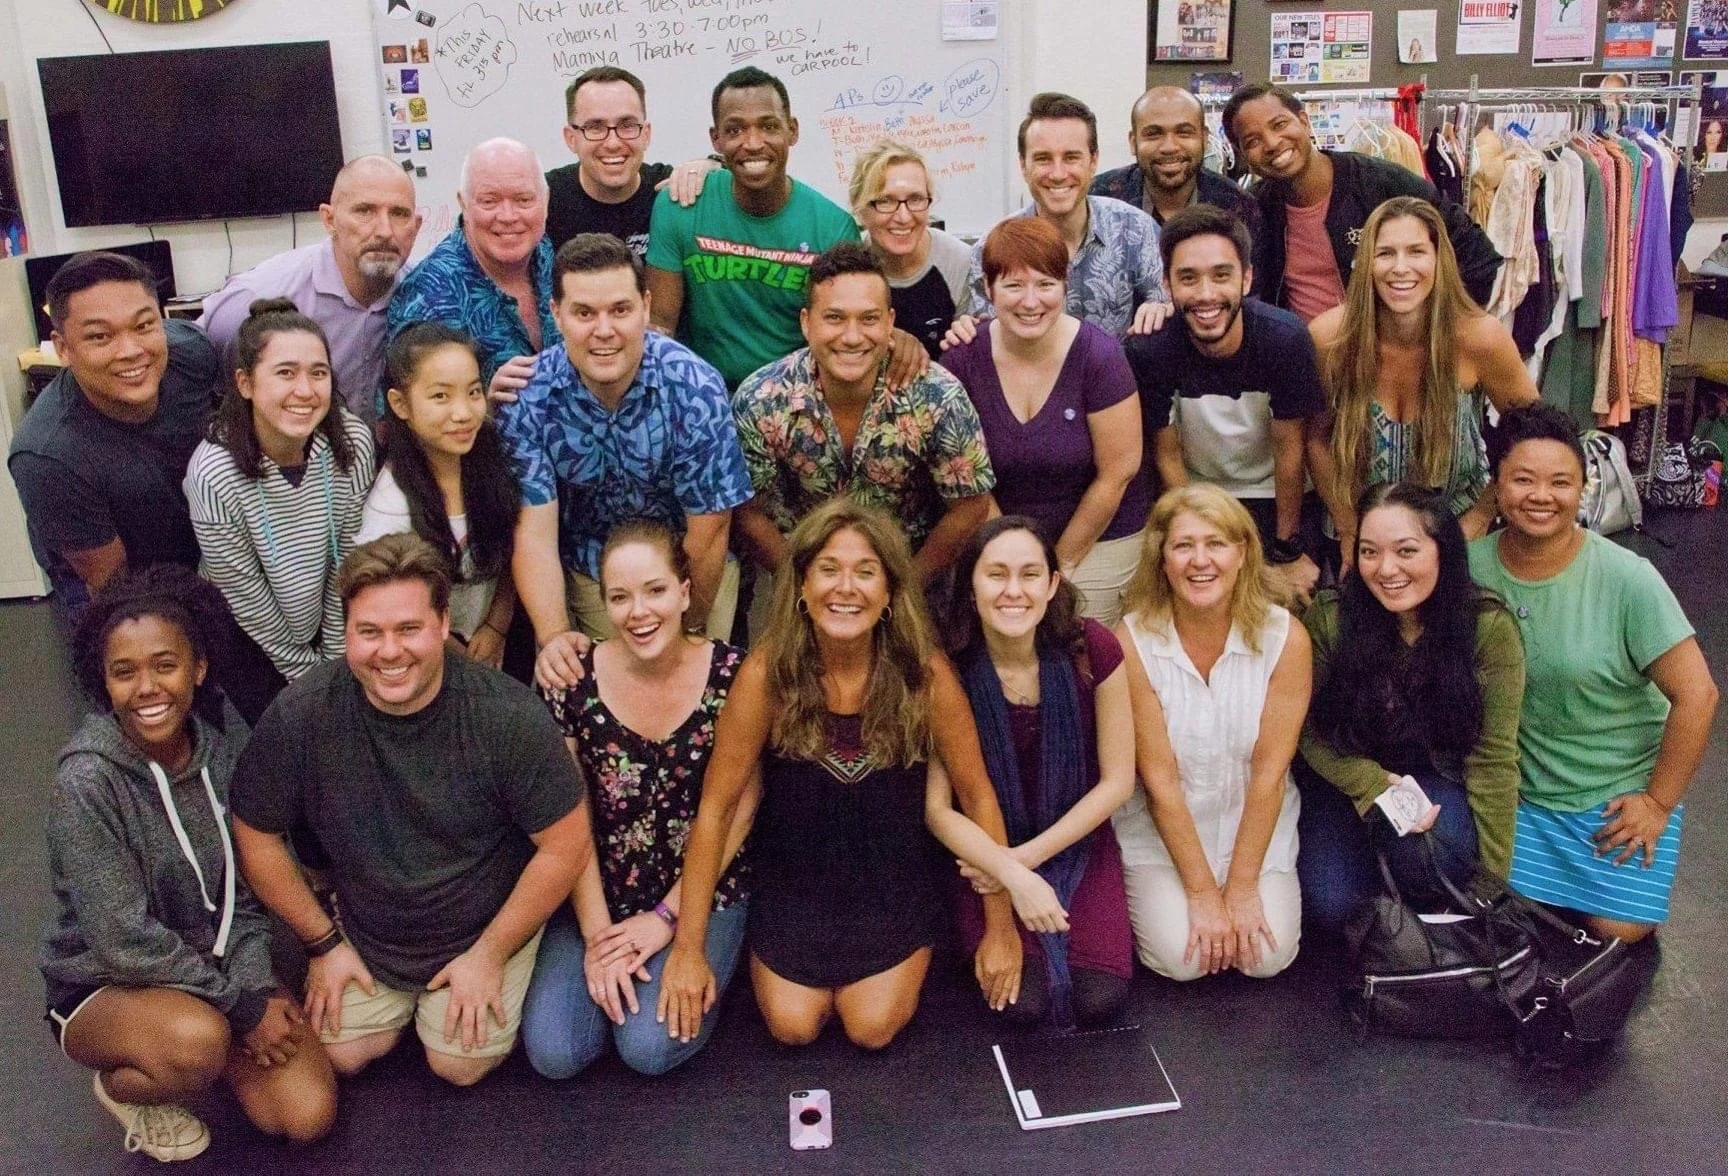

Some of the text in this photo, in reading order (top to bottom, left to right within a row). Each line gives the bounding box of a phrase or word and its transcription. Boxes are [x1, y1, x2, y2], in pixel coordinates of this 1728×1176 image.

[517, 1, 567, 26] Next
[1464, 3, 1484, 18] BILLY
[454, 24, 492, 69] FRIDAY
[629, 40, 697, 63] Theatre
[726, 36, 755, 54] NO
[842, 39, 859, 53] to
[699, 237, 746, 256] TEENAGE
[745, 243, 785, 262] MUTANT
[683, 254, 811, 291] TURTLE
